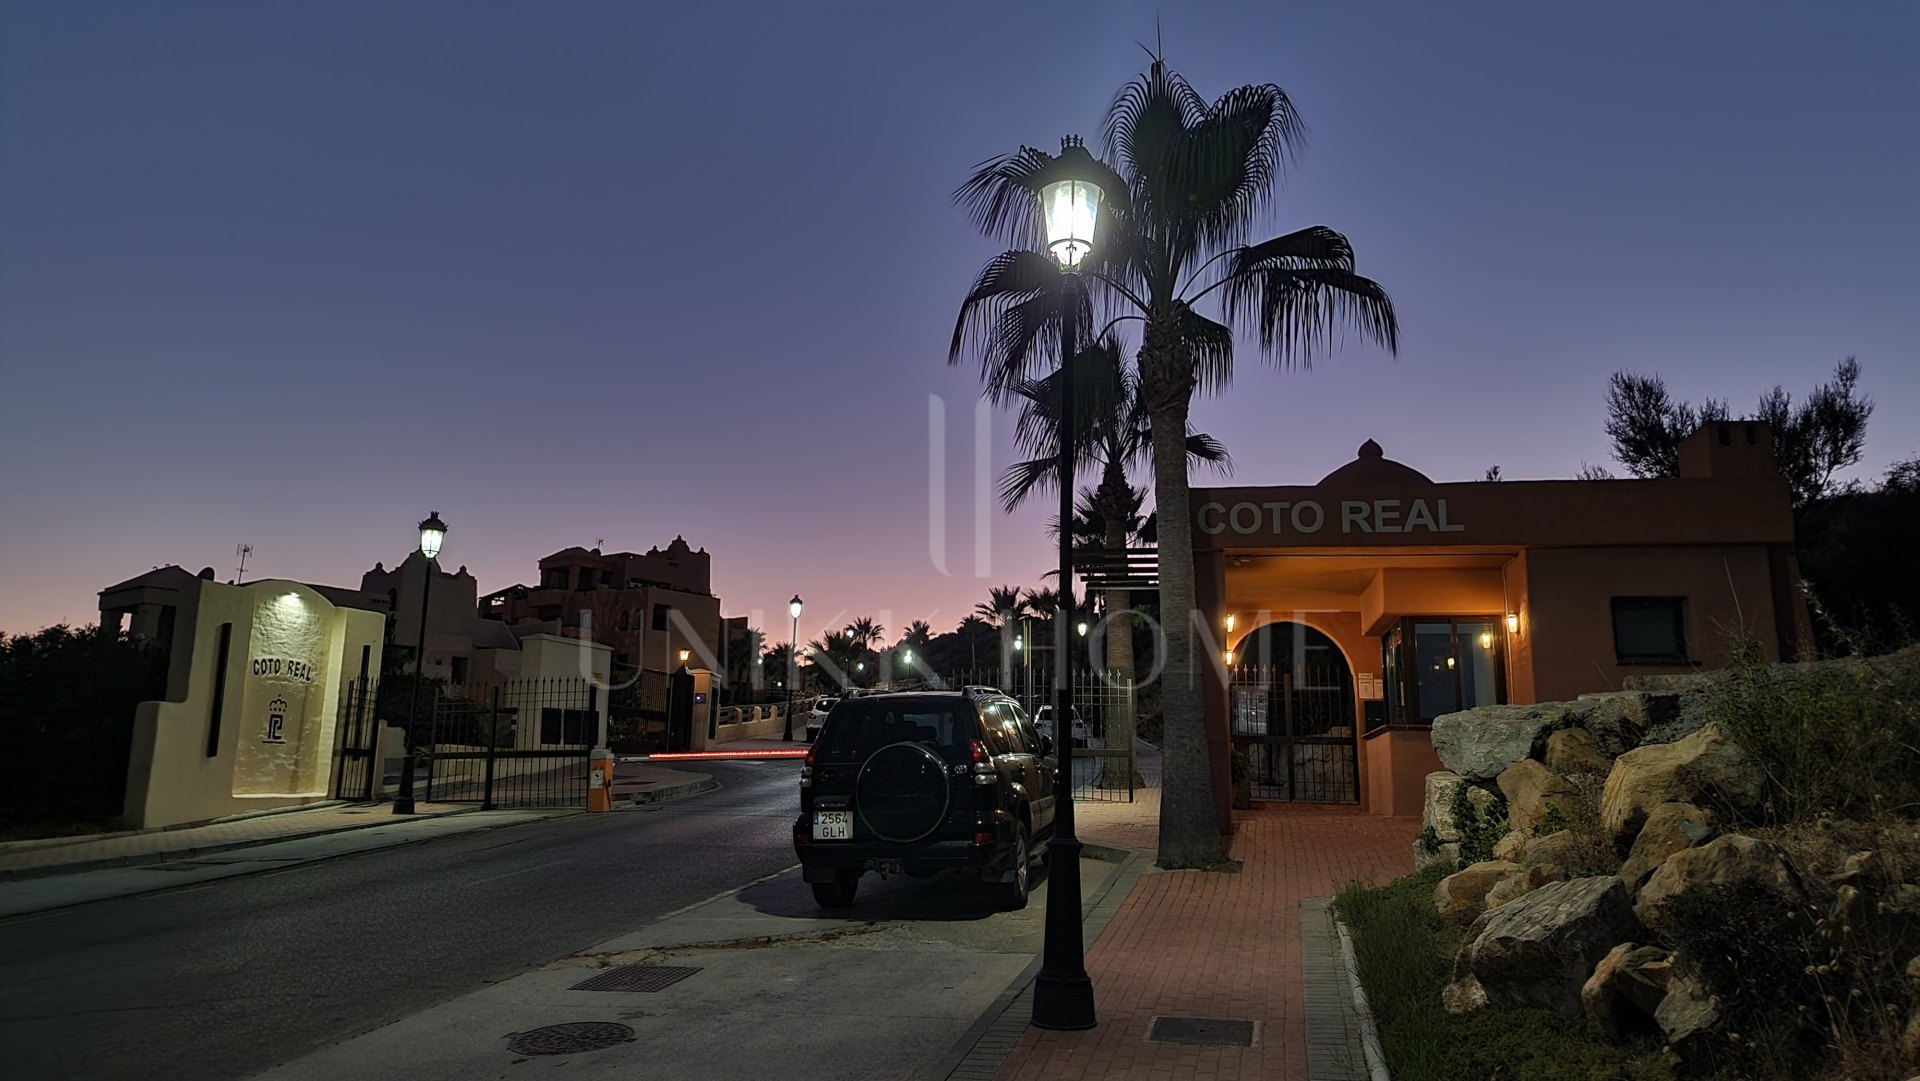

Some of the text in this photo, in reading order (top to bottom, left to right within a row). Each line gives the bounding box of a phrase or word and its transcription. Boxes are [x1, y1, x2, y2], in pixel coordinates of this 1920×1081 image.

[1197, 499, 1465, 535] COTO REAL
[252, 658, 312, 682] COTO REAL
[821, 811, 848, 825] 2564
[822, 827, 845, 838] GLH
